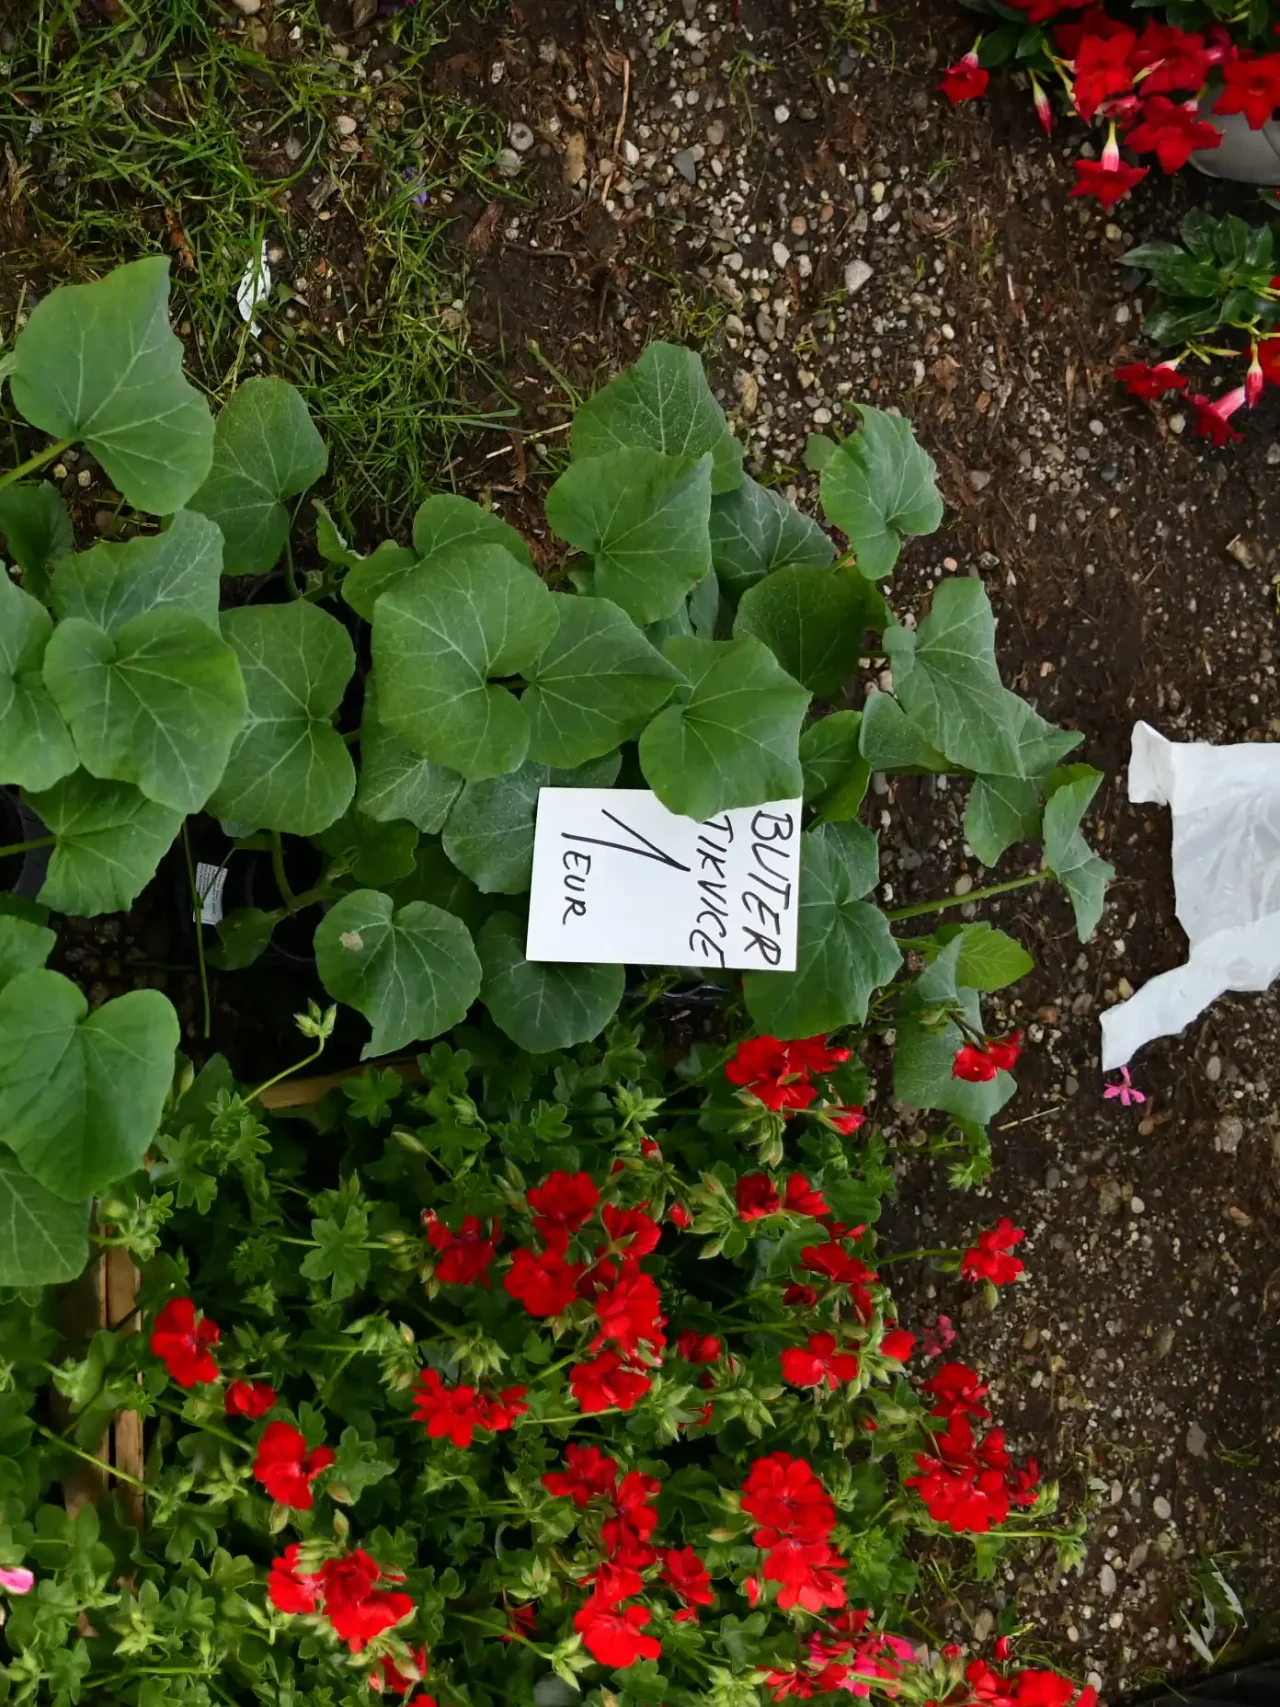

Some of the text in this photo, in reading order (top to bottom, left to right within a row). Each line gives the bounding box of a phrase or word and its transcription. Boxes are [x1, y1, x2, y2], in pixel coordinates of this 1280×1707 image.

[561, 808, 691, 926] 1 EUR
[689, 814, 734, 969] TIKVICE
[741, 809, 795, 967] BUTER
